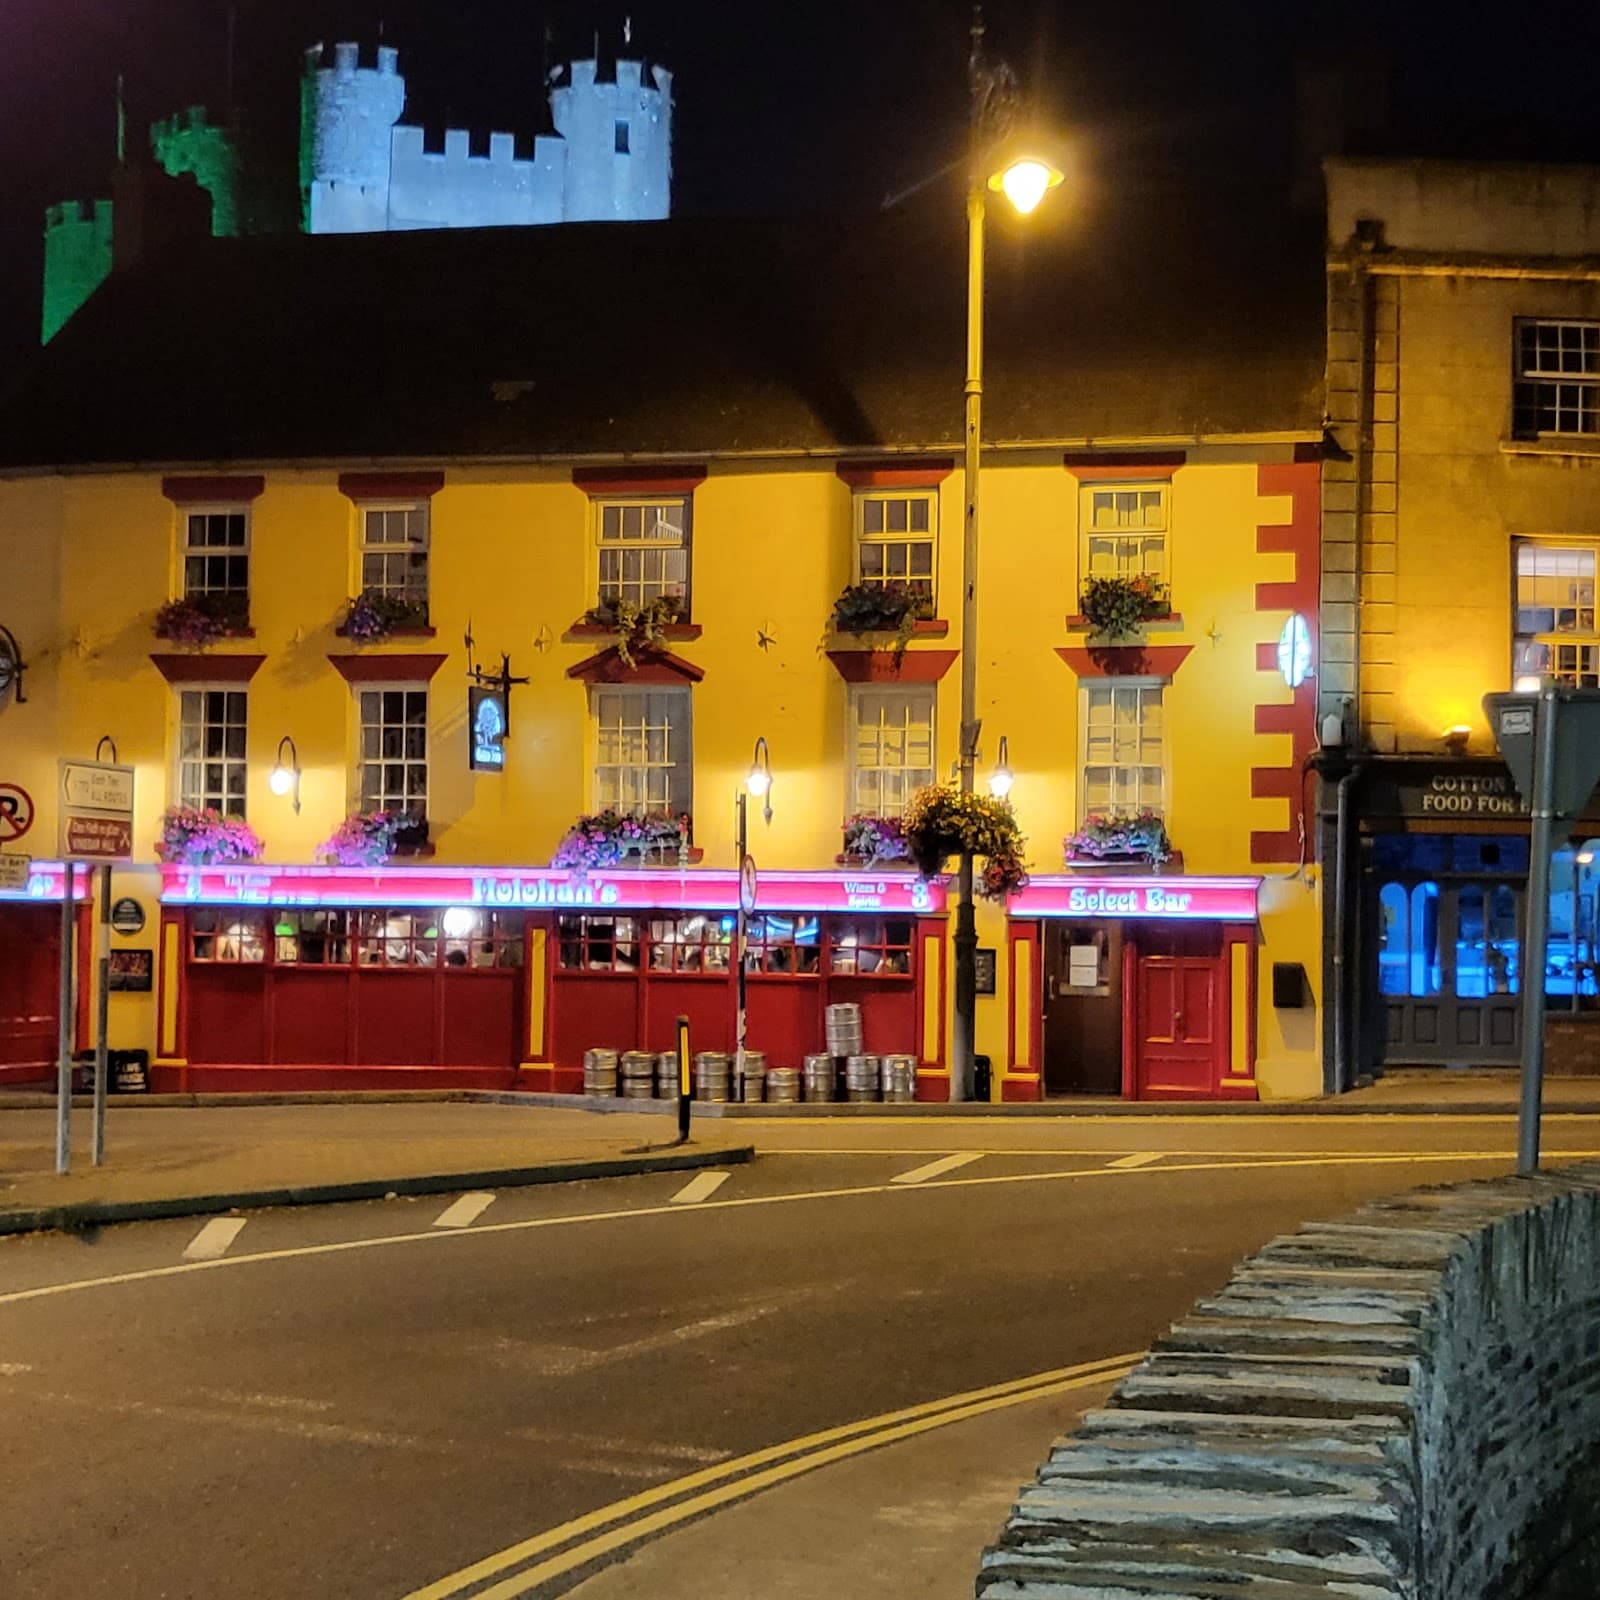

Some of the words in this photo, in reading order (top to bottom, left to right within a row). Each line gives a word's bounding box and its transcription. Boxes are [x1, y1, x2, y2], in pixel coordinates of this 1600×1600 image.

[1431, 775, 1505, 792] COTTON
[1422, 794, 1473, 812] FOOD
[1477, 795, 1514, 813] FOR
[472, 877, 619, 905] Holohan's
[1069, 886, 1137, 912] Select
[1144, 887, 1192, 913] Bar
